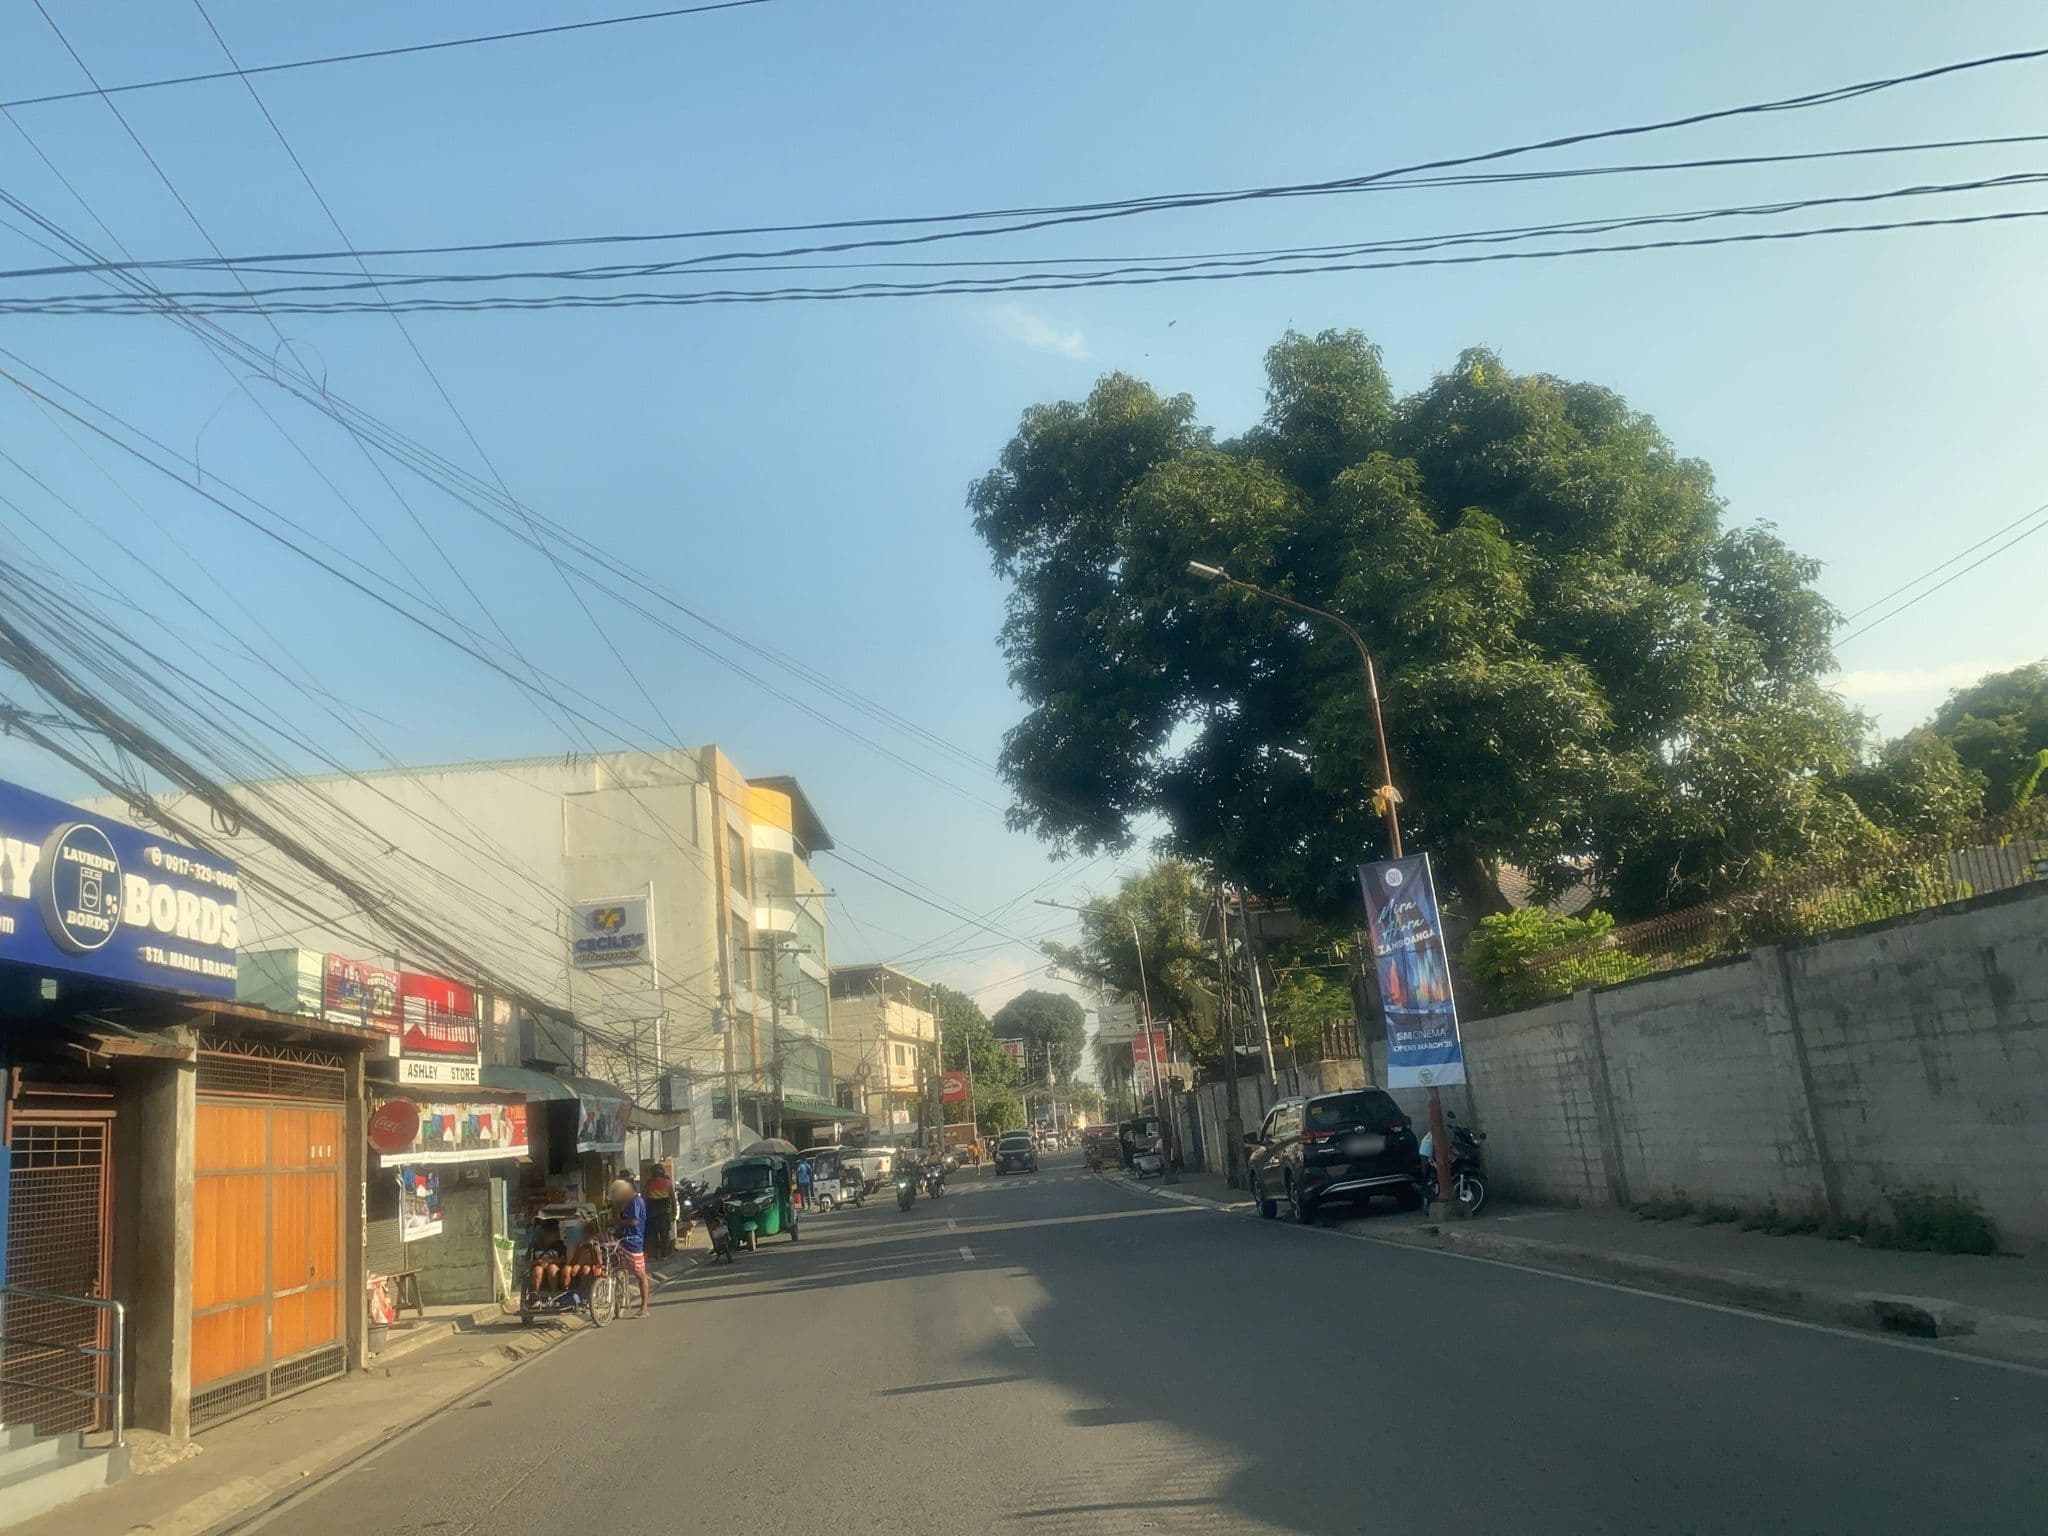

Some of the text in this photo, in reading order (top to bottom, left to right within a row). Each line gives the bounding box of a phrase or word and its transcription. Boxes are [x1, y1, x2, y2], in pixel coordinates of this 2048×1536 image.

[0, 837, 40, 899] Y
[63, 846, 117, 873] LAUNDRY
[66, 910, 110, 932] BORDS
[124, 873, 238, 949] BORDS
[1377, 929, 1436, 954] ZAMBOANGA
[145, 946, 238, 980] STA. MARIA BRANCH
[427, 992, 476, 1043] Marlboro
[408, 1064, 475, 1081] ASHLEY STORE
